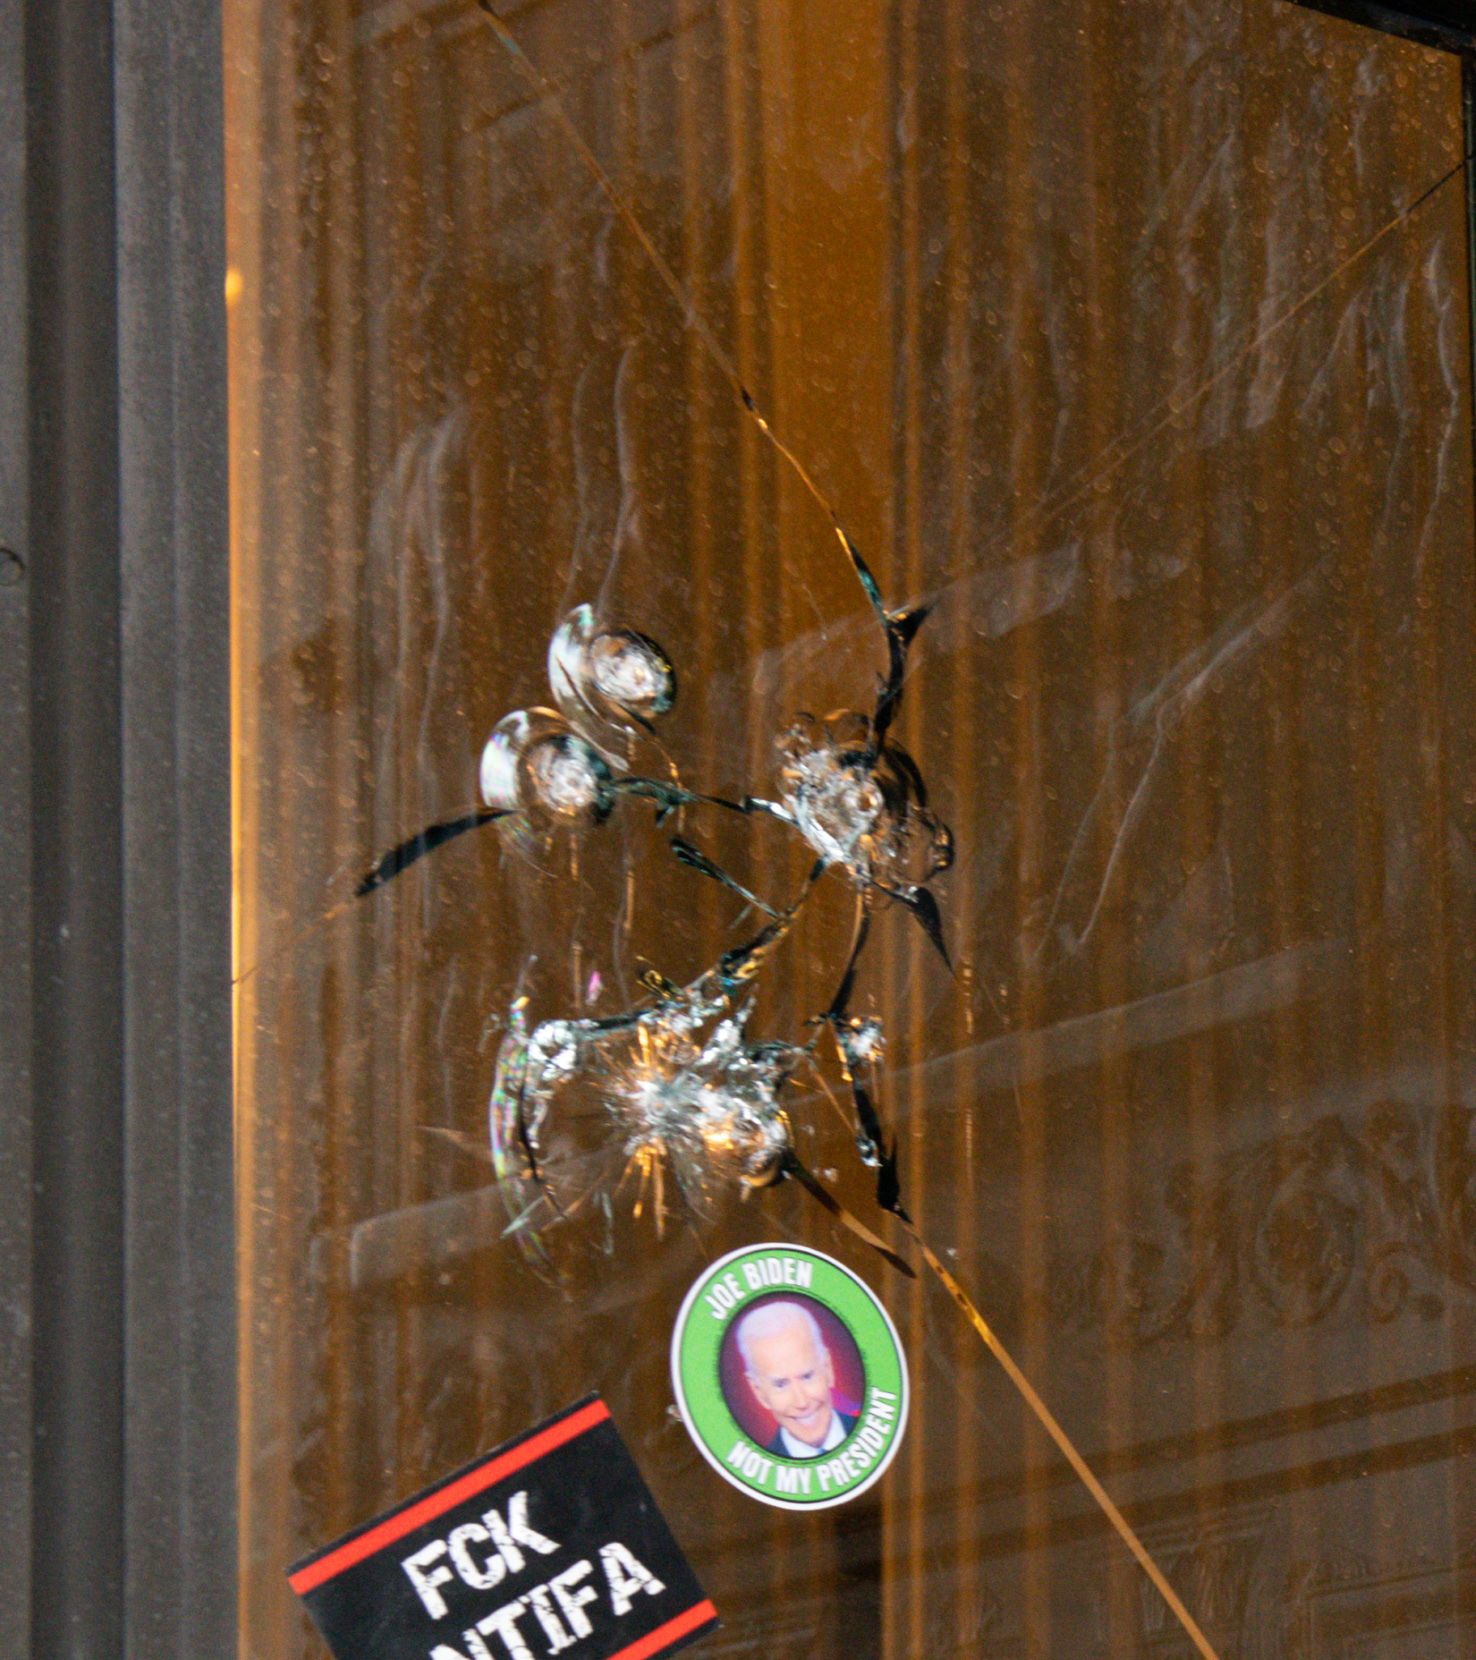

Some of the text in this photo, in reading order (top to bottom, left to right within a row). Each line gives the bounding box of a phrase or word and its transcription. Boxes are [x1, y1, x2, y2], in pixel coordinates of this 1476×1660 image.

[705, 1257, 812, 1320] JOE BIDEN
[727, 1387, 898, 1494] NOT MY PRESIDENT
[401, 1491, 559, 1620] FCK
